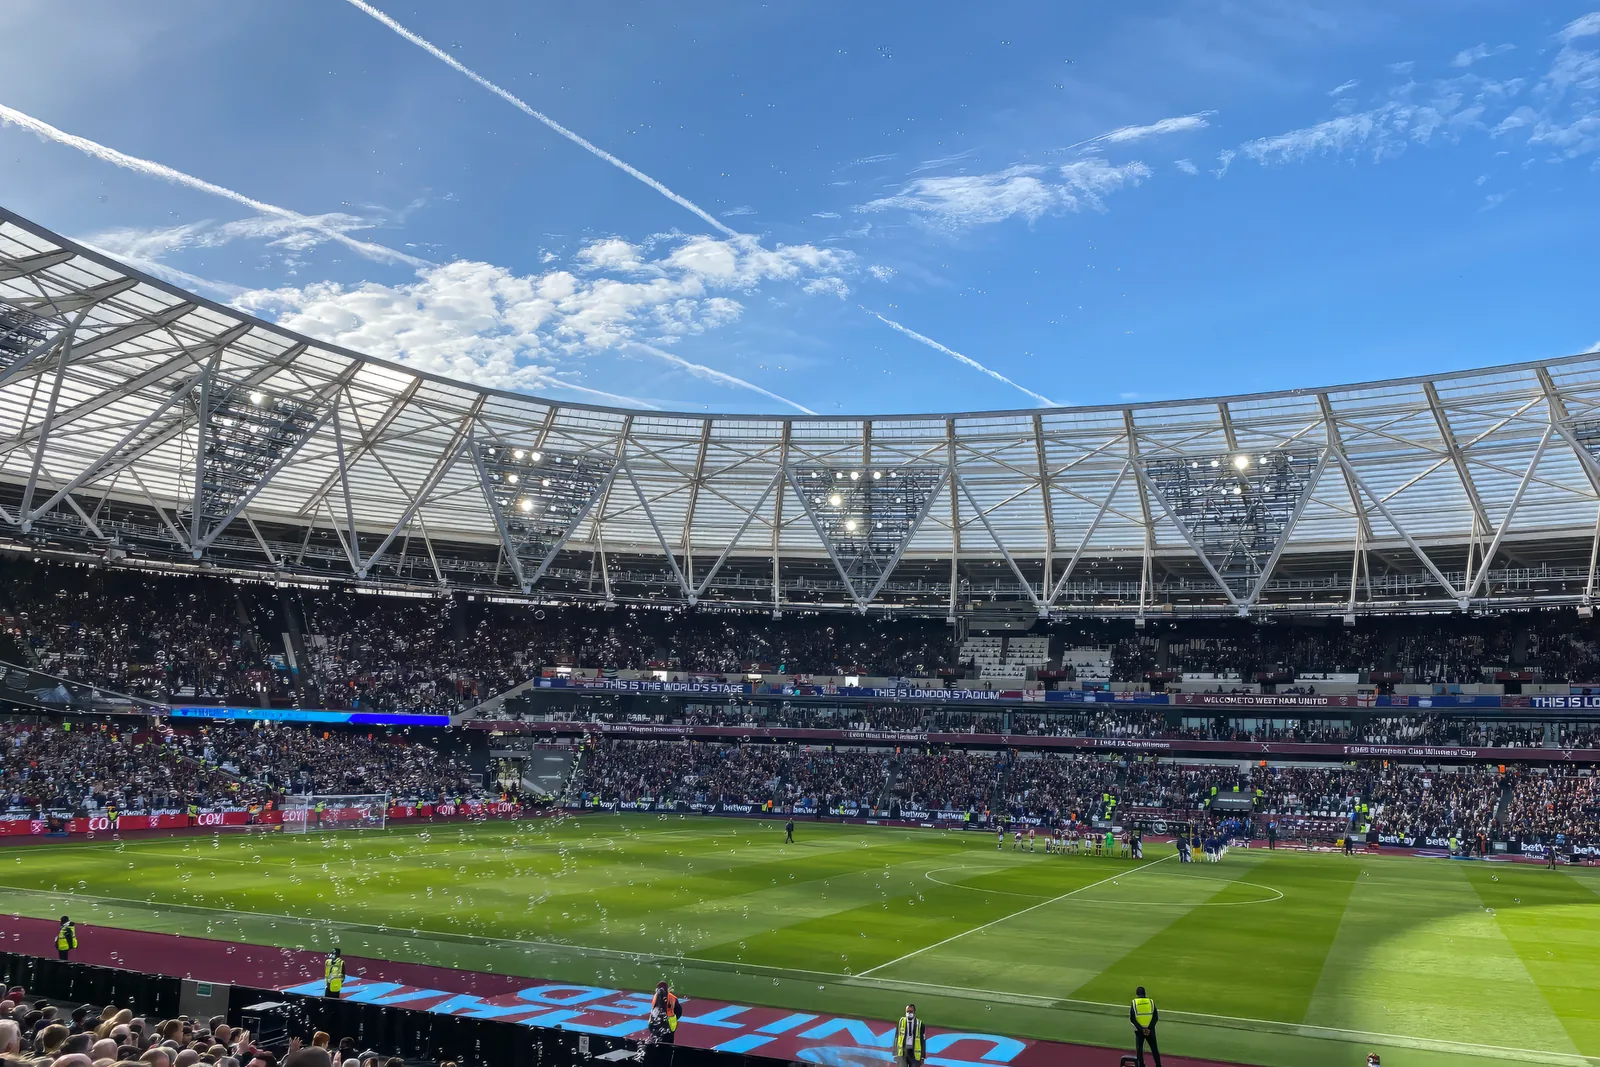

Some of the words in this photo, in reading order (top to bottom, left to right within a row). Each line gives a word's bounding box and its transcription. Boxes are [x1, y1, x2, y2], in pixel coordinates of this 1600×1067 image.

[603, 680, 627, 690] THIS
[629, 681, 639, 690] IS
[641, 682, 661, 691] THE
[663, 683, 709, 693] WORLD'S
[711, 684, 744, 694] STAGE
[872, 688, 896, 698] THIS
[897, 688, 907, 698] IS
[909, 689, 951, 699] LONDON
[953, 690, 1000, 700] STADIUM
[1203, 696, 1241, 704] WELCOME
[1255, 697, 1277, 705] WEST
[1279, 697, 1297, 705] HAM
[1298, 697, 1328, 705] UNITED
[1532, 697, 1565, 708] THIS
[1568, 697, 1581, 708] IS
[1370, 747, 1406, 755] European
[1408, 748, 1423, 756] Cup
[1460, 749, 1477, 757] Cup
[585, 800, 614, 810] beway
[723, 803, 753, 813] betway
[937, 811, 965, 820] betwa
